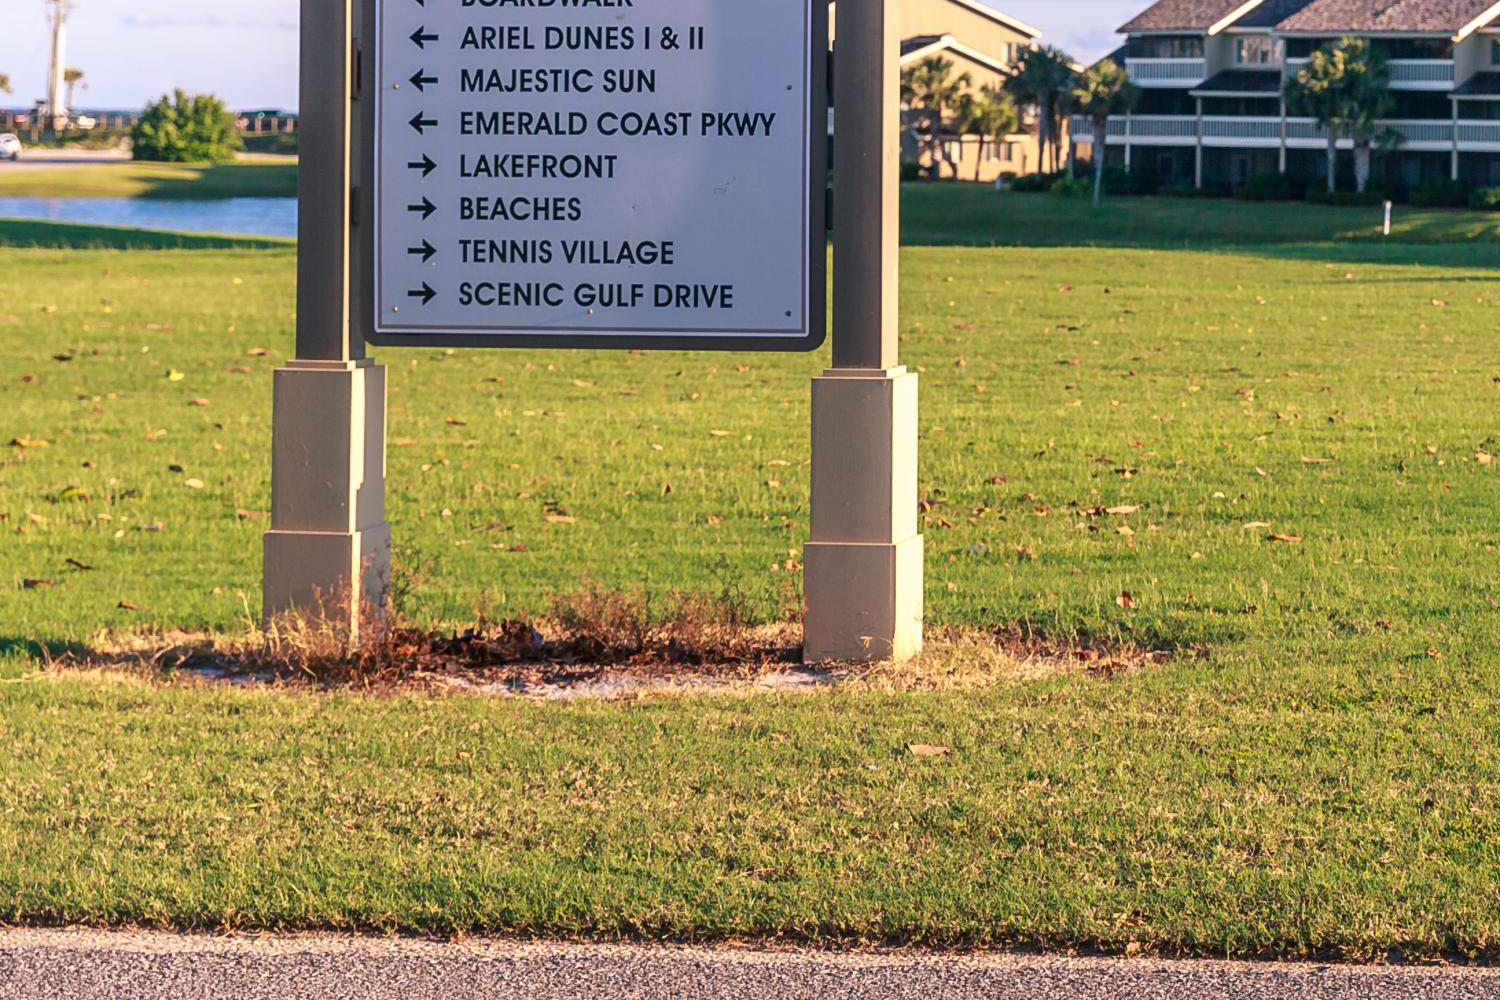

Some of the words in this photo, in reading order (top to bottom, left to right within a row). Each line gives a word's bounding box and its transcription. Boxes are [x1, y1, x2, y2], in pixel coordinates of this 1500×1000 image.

[459, 25, 536, 50] ARIEL
[544, 25, 635, 51] DUNES
[644, 26, 650, 50] I
[659, 25, 680, 51] &
[689, 26, 704, 50] II
[460, 68, 594, 93] MAJESTIC
[602, 68, 656, 94] SUN
[460, 111, 588, 136] EMERALD
[596, 111, 692, 137] COAST
[701, 112, 777, 137] PKWY
[460, 153, 618, 179] LAKEFRONT
[459, 196, 582, 222] BEACHES
[458, 239, 553, 264] TENNIS
[560, 239, 674, 265] VILLAGE
[458, 281, 565, 307] SCENIC
[573, 282, 644, 308] GULF
[653, 283, 734, 309] DRIVE
